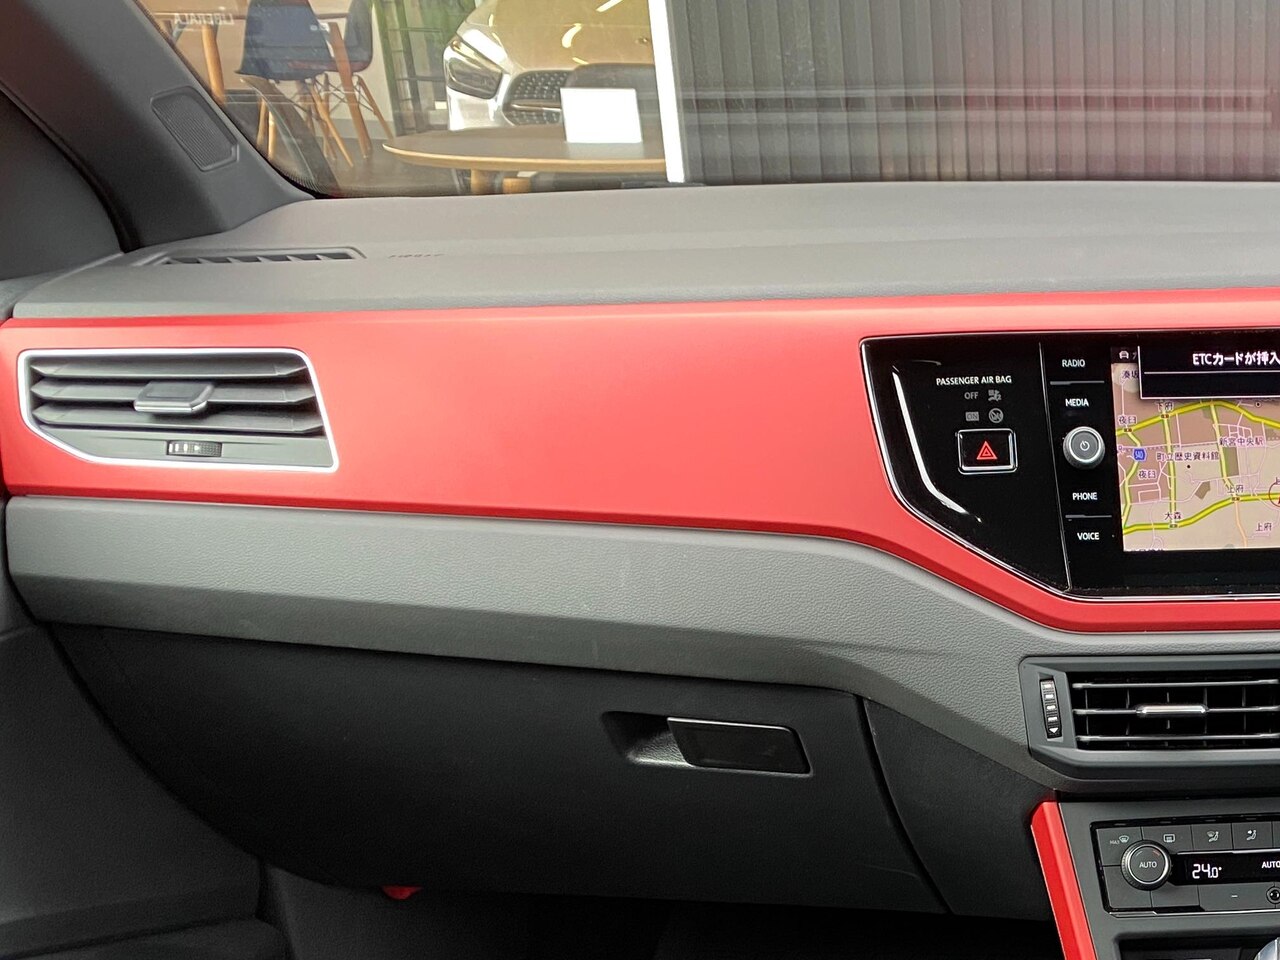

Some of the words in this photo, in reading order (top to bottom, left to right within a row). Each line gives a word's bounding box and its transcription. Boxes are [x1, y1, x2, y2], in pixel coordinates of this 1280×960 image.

[1062, 359, 1086, 368] RADIO
[936, 377, 979, 386] PASSENGER
[981, 376, 994, 384] AIR
[995, 375, 1012, 384] BAG
[964, 391, 979, 400] OFF
[1065, 398, 1089, 407] MEDIA
[1072, 492, 1098, 501] PHONE
[1077, 532, 1100, 541] VOICE
[1139, 861, 1158, 869] AUTO
